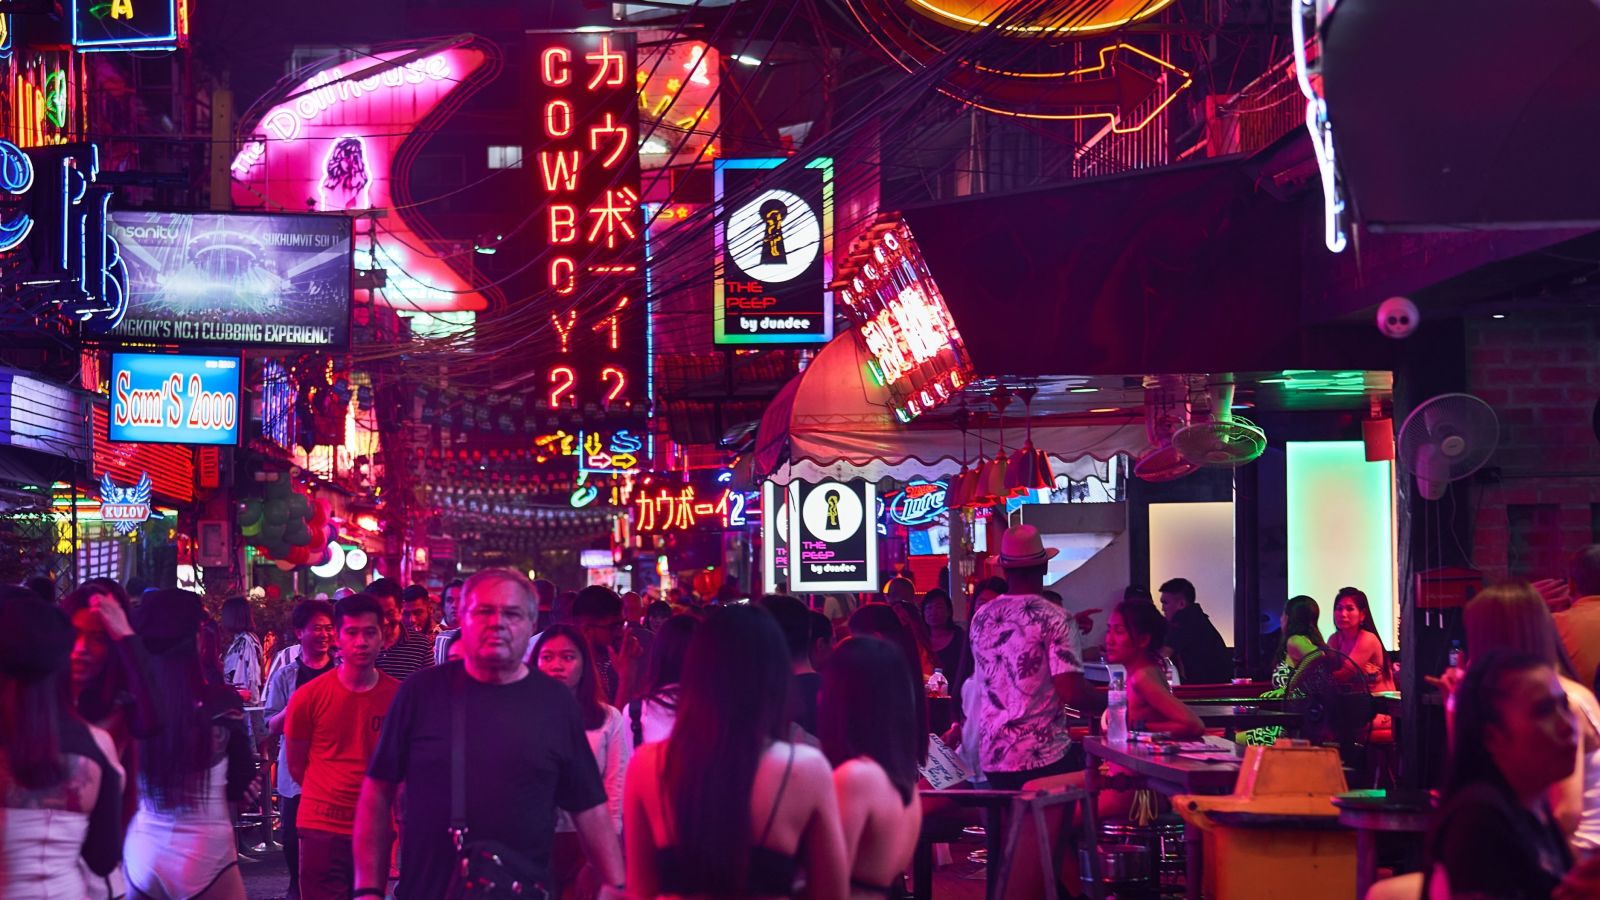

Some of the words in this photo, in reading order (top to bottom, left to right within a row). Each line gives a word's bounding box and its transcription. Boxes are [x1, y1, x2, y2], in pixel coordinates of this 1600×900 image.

[263, 54, 452, 143] Dollhouse
[263, 231, 313, 247] SUKHUMVIT
[314, 234, 330, 247] SOI
[727, 281, 763, 294] THE
[727, 297, 776, 310] PEEP
[740, 316, 758, 333] by
[760, 316, 811, 330] dundee
[173, 322, 200, 339] NO.1
[202, 322, 262, 342] CLUBBING
[264, 324, 336, 345] EXPERIENCE
[187, 373, 237, 431] 2000
[105, 506, 145, 518] KULOV
[802, 541, 826, 550] THE
[802, 551, 835, 560] PEEP
[810, 563, 823, 575] by
[824, 563, 856, 573] dundee
